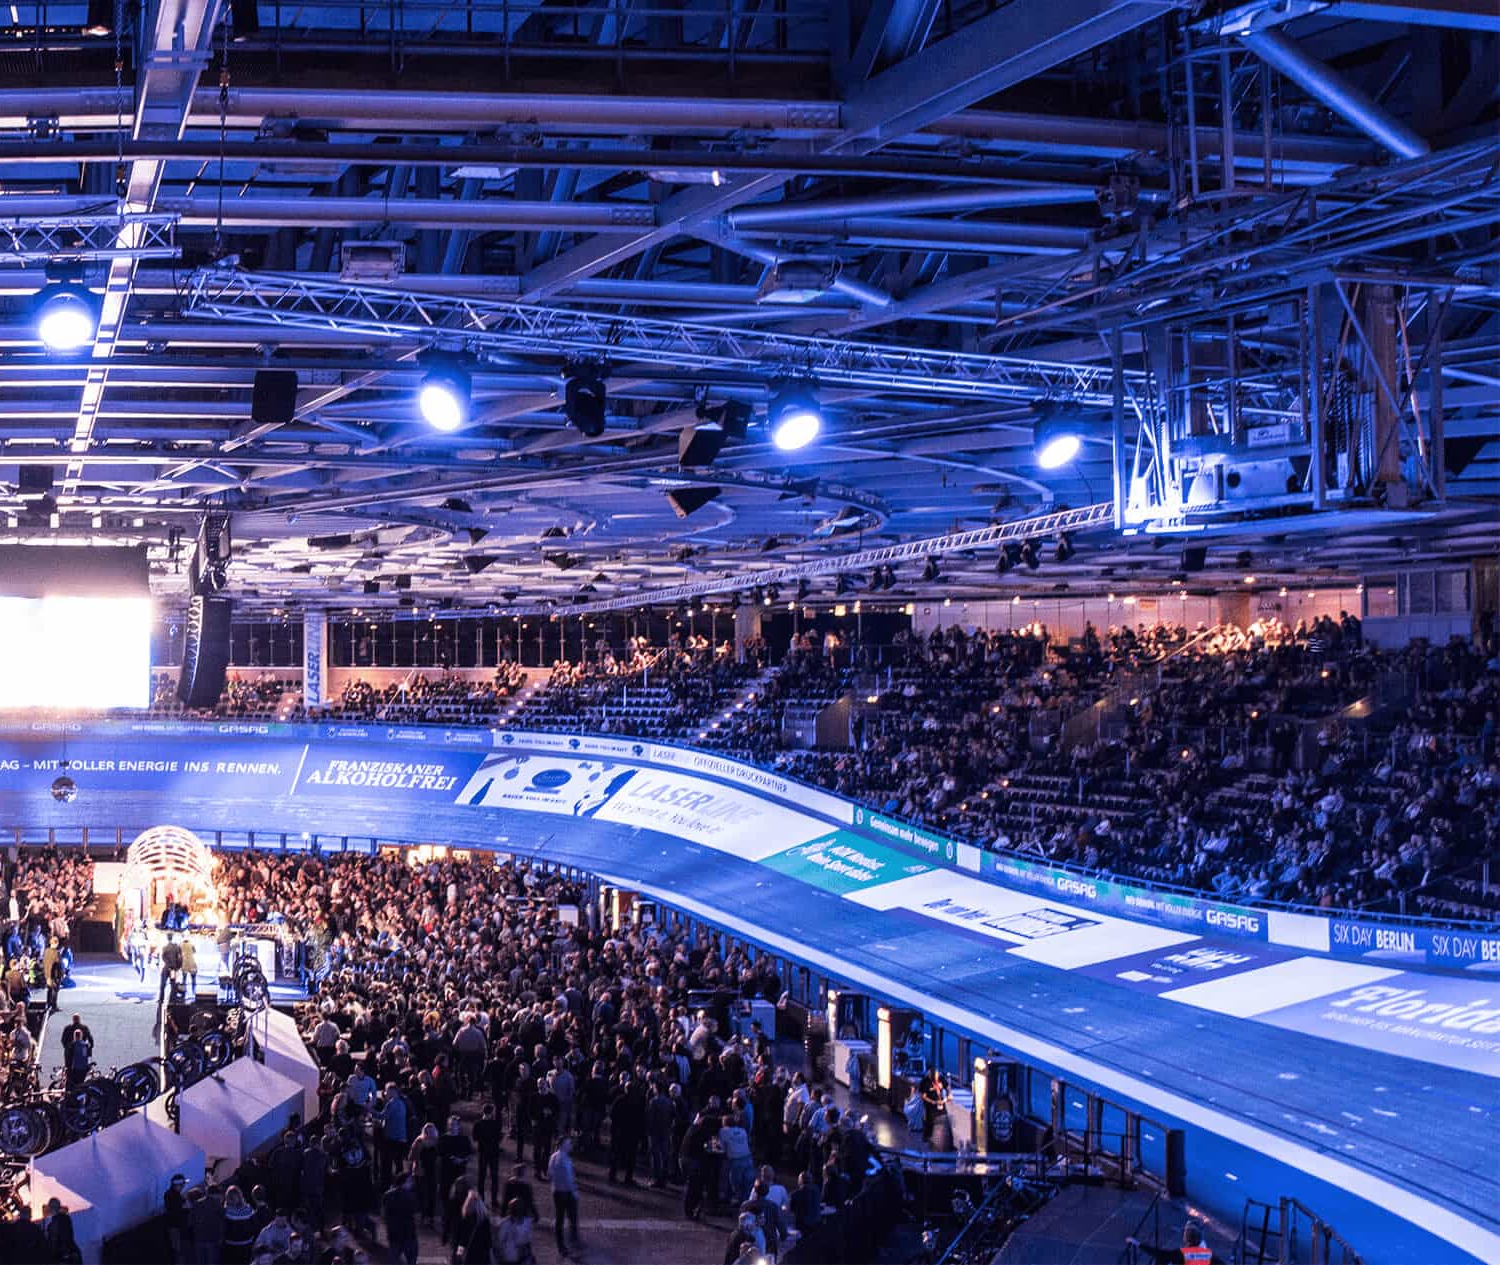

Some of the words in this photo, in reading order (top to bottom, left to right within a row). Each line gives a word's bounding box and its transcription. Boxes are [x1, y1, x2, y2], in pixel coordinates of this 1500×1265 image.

[33, 760, 58, 770] MIT
[118, 760, 179, 772] ENERGIE
[184, 761, 210, 773] INS
[216, 762, 282, 775] RENNEN.
[329, 759, 445, 776] FRANZISKANER
[306, 769, 459, 791] ALKOHOLFREI
[1056, 877, 1097, 899] GASAG
[1205, 908, 1260, 933] GASAG
[1333, 923, 1350, 945] SIX
[1351, 925, 1373, 947] DAY
[1376, 929, 1416, 953] BERLIN
[1431, 934, 1451, 957] SIX
[1452, 936, 1479, 960] DAY
